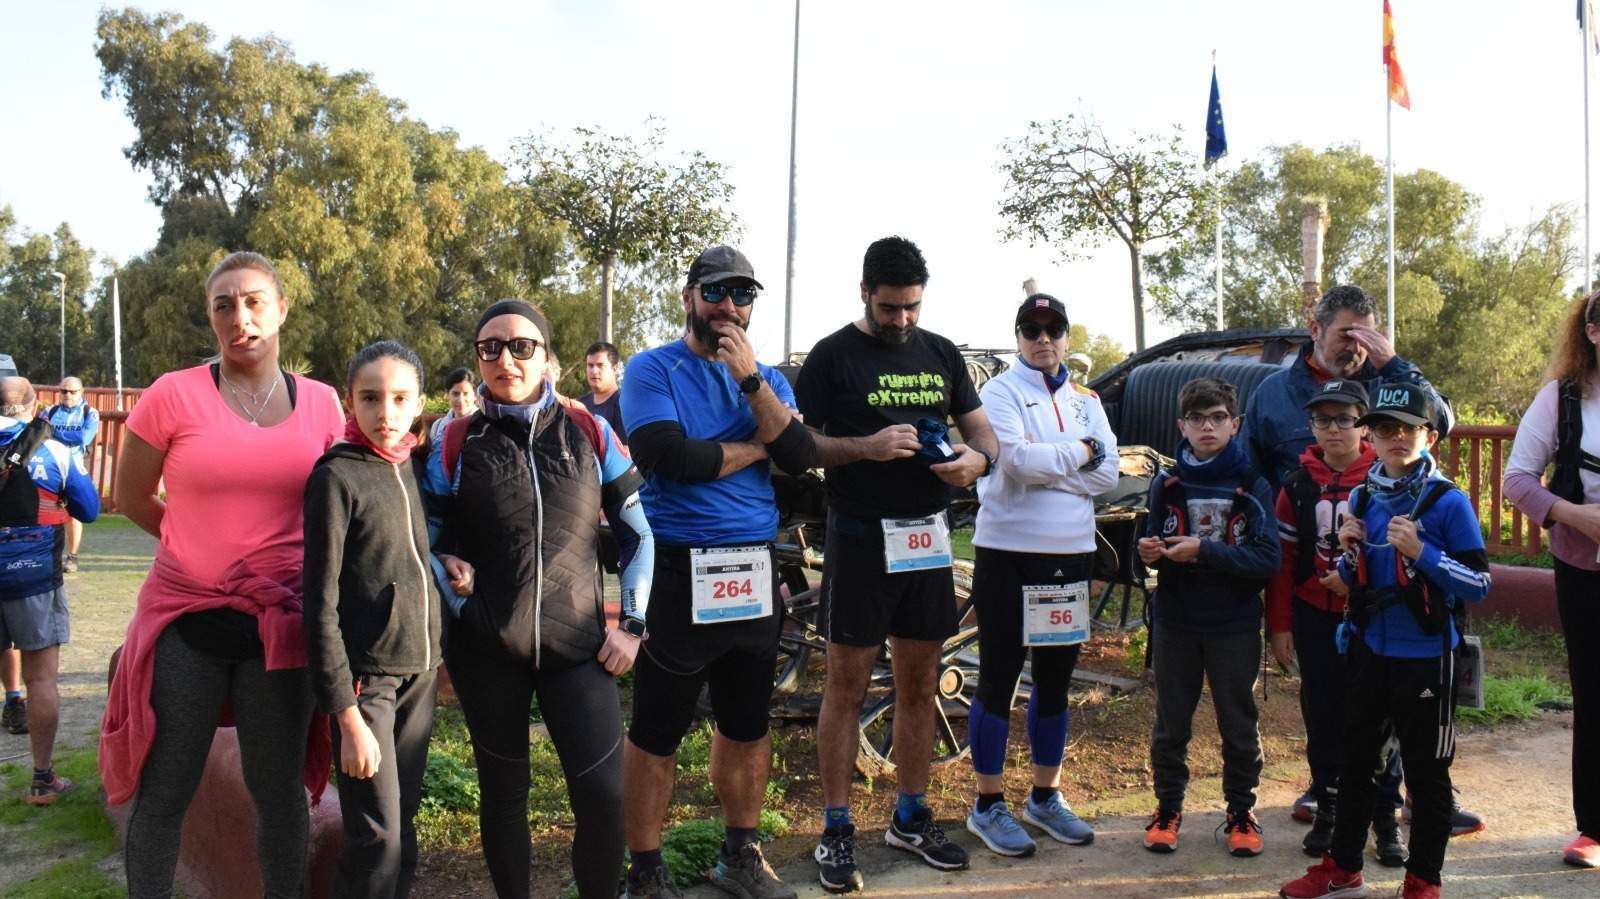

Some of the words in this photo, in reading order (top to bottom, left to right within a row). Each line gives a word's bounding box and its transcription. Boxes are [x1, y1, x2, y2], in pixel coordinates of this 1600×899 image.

[1376, 388, 1409, 407] LUCA
[908, 532, 932, 550] 80
[713, 578, 753, 599] 264
[1050, 608, 1073, 625] 56
